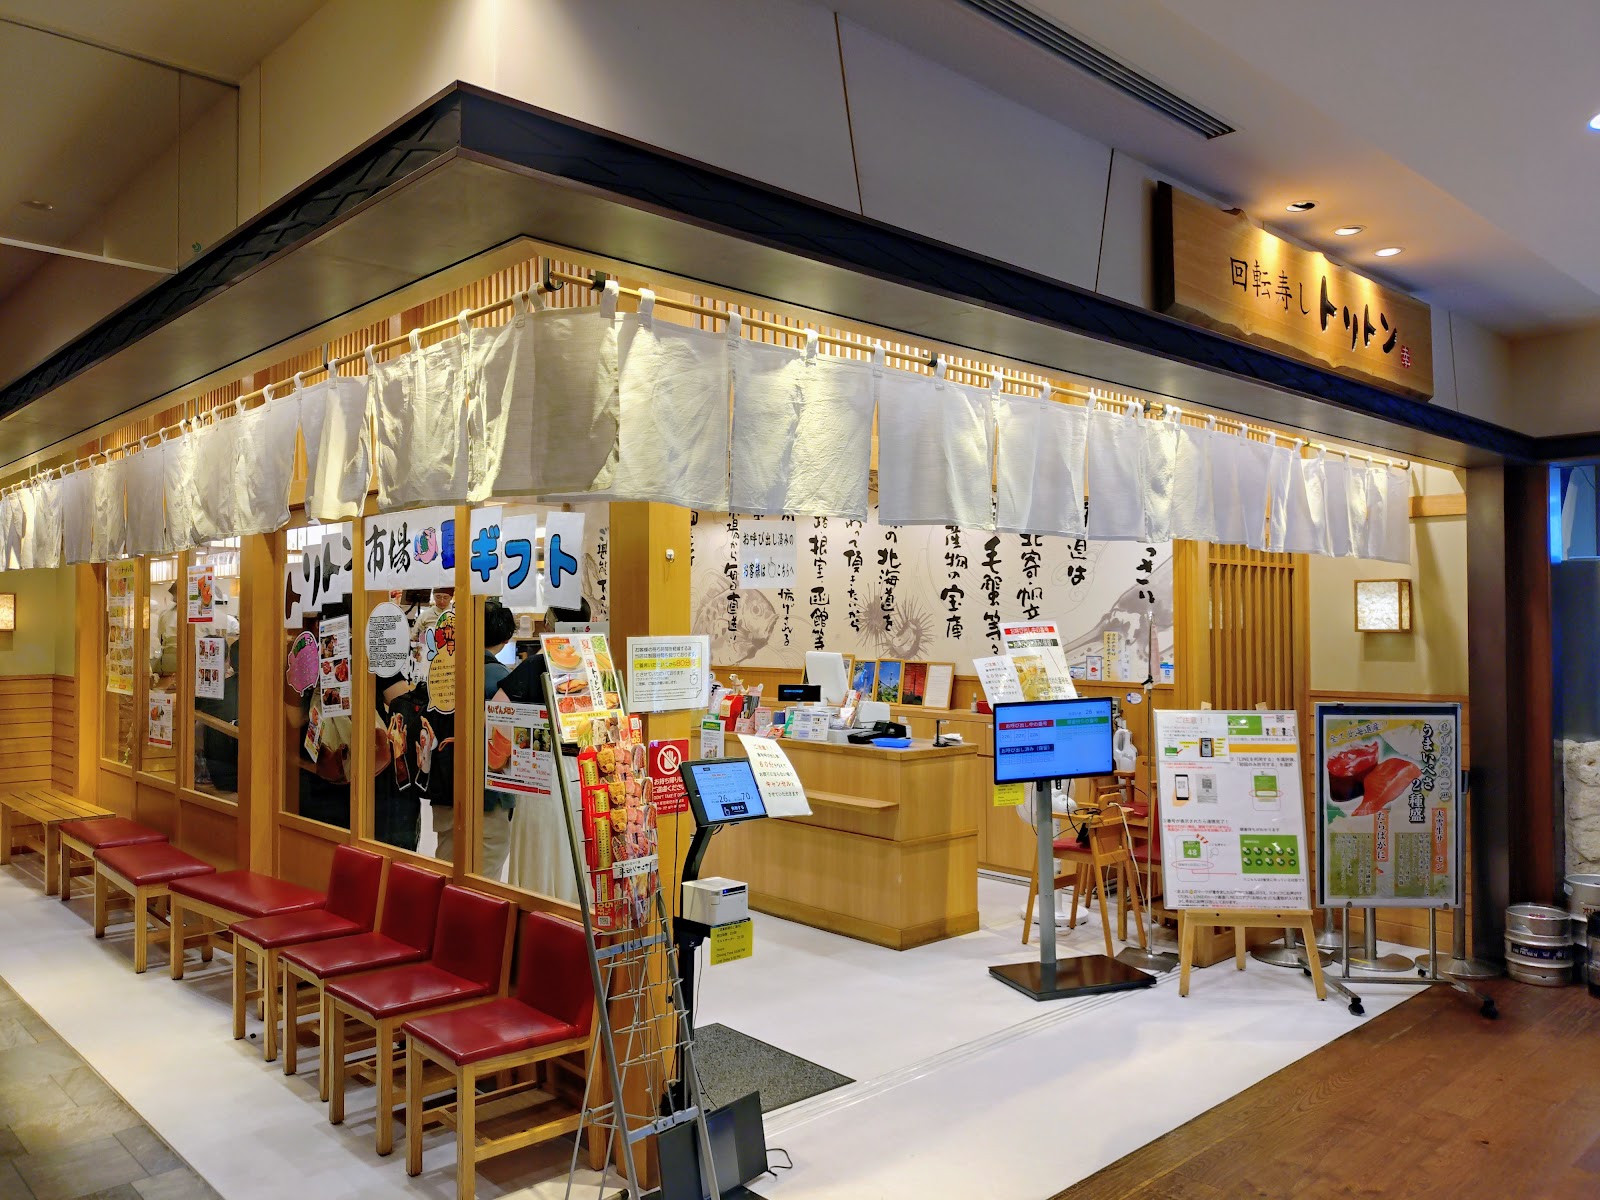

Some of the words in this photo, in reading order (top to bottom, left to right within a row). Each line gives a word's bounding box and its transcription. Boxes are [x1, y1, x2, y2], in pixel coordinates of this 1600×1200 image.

[1229, 256, 1310, 315] 回転寿し
[1319, 274, 1398, 354] トリトン
[471, 523, 577, 589] ギフト
[1421, 723, 1437, 791] うまいべさ
[717, 794, 728, 803] 26
[1408, 778, 1426, 824] 2種盛
